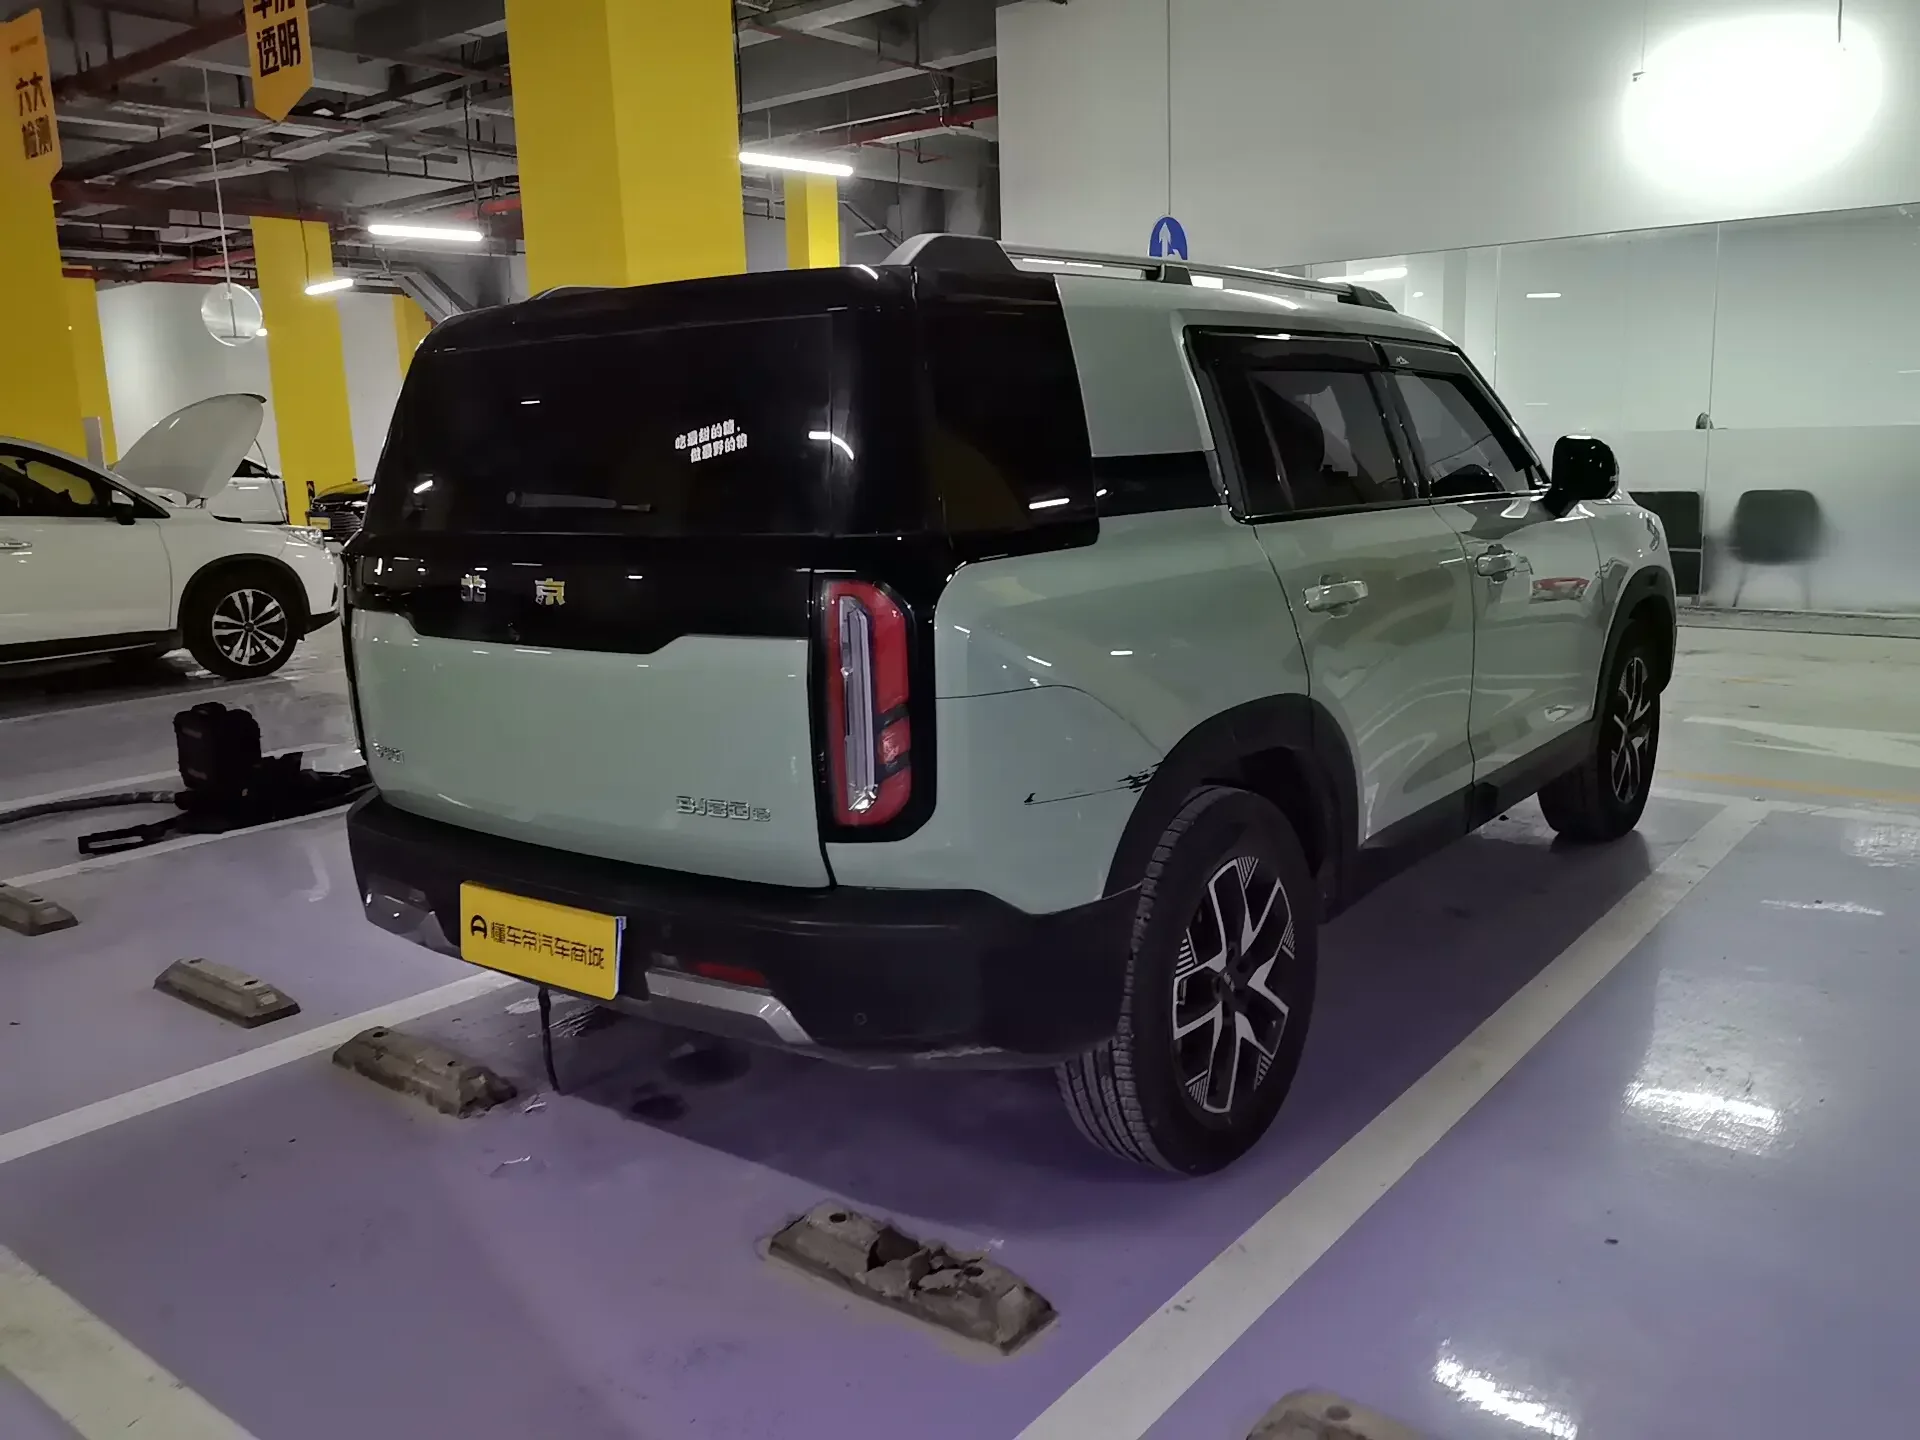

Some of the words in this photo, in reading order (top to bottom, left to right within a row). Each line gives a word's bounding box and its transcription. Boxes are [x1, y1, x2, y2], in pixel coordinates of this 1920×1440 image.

[256, 17, 302, 77] 透明
[16, 71, 47, 117] 六大
[460, 573, 566, 606] 北京
[491, 921, 605, 970] 懂车帝汽车商城
